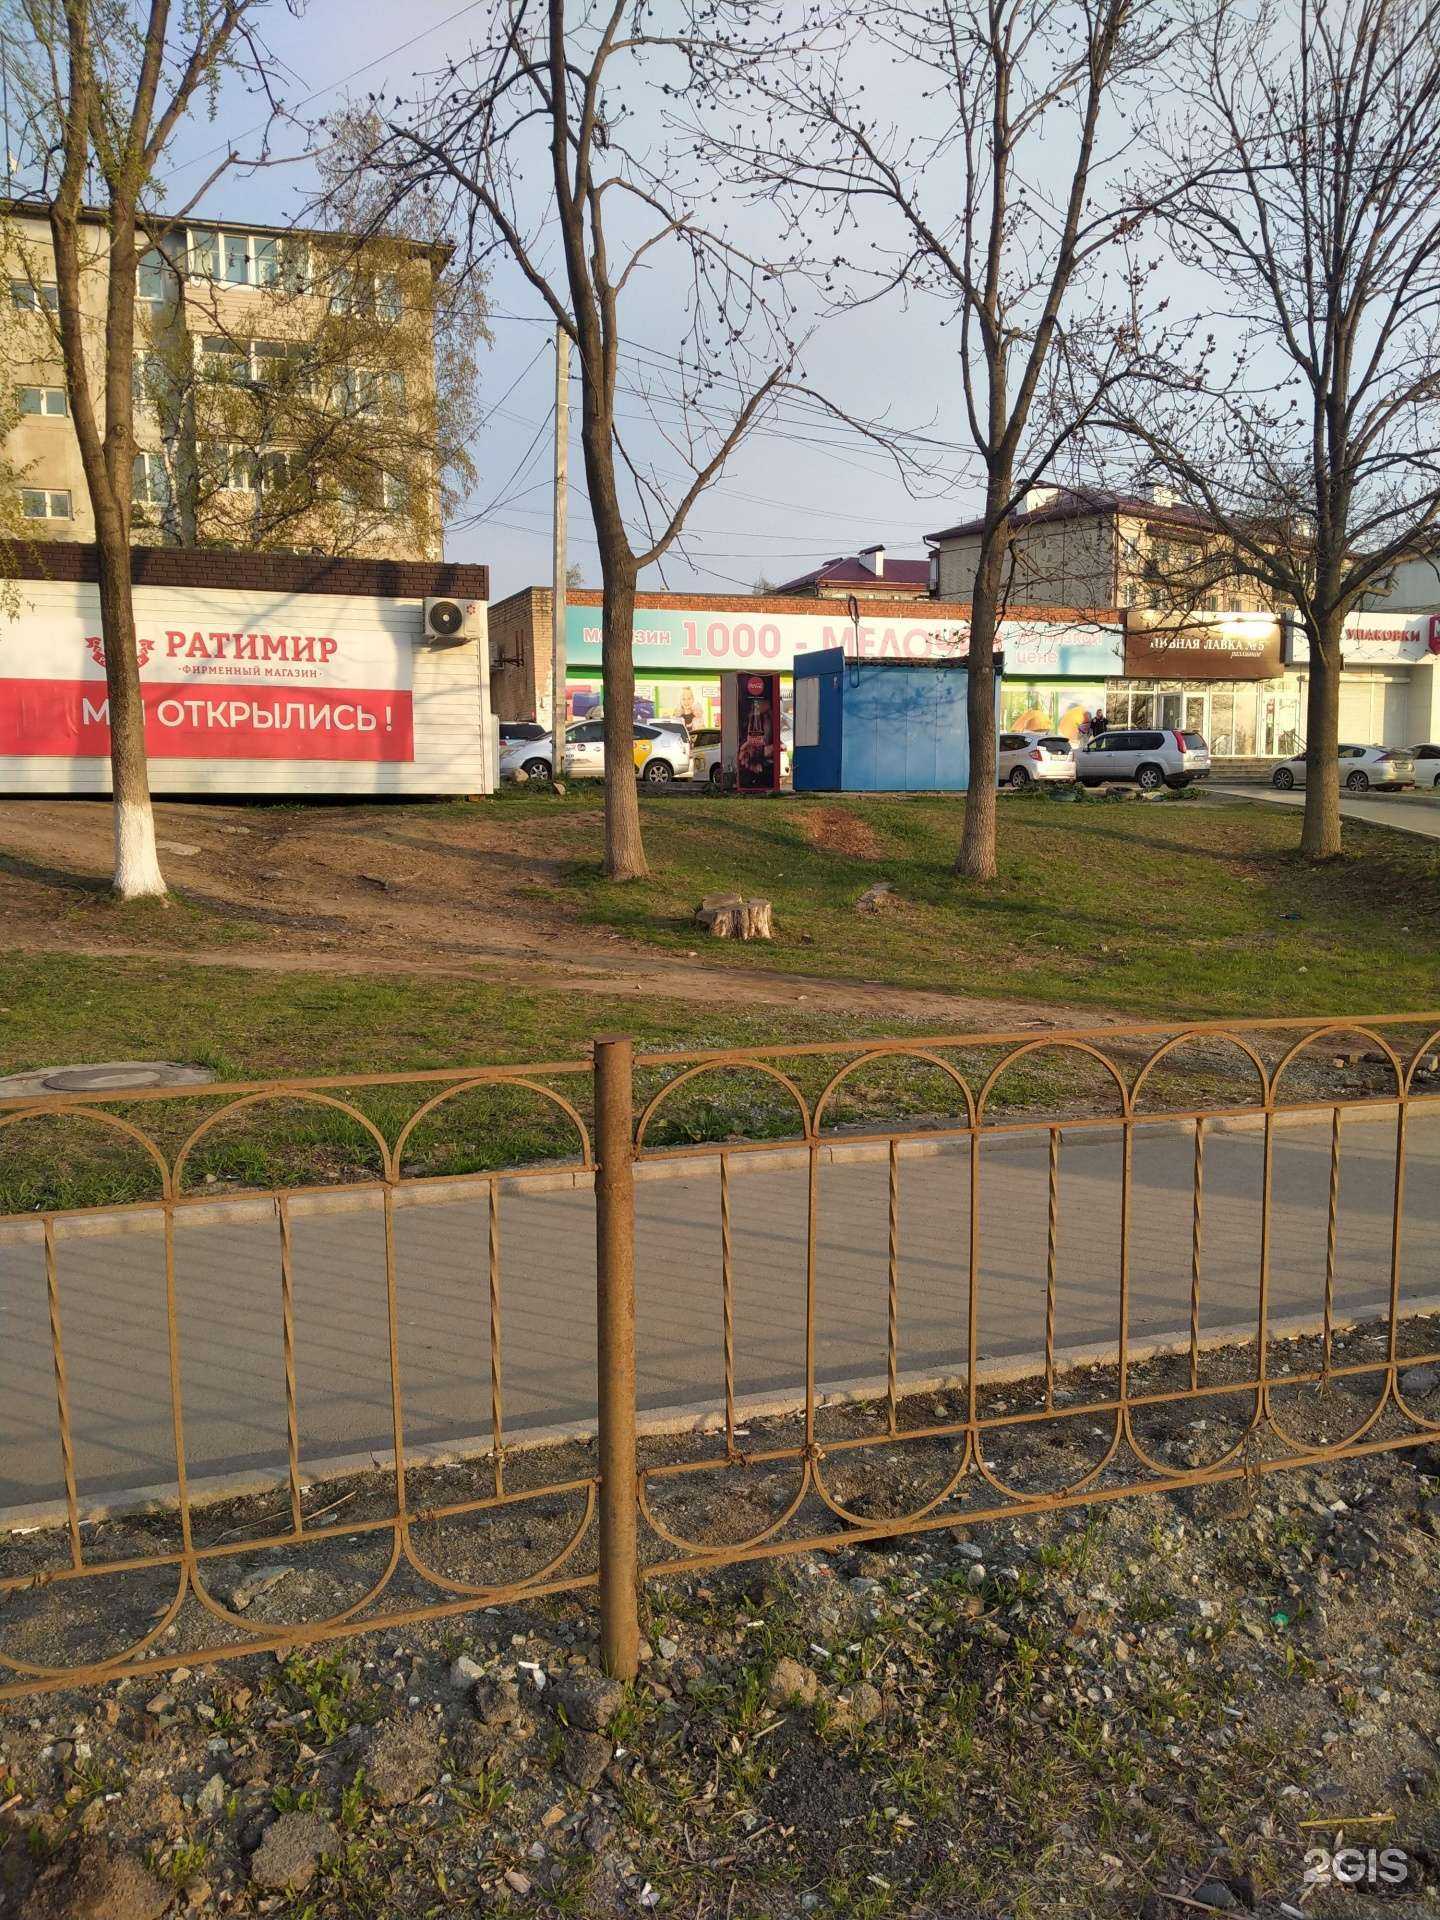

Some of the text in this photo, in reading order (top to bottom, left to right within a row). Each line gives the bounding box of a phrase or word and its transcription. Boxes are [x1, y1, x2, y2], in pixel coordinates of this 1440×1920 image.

[164, 630, 338, 663] РАТИМИР
[682, 619, 781, 659] 1000
[1203, 639, 1242, 650] ЛАВКА
[182, 664, 317, 679] ФИРМЕННЫЙ МАГАЗИН
[157, 699, 377, 732] ОТКРЫЛИСЬ
